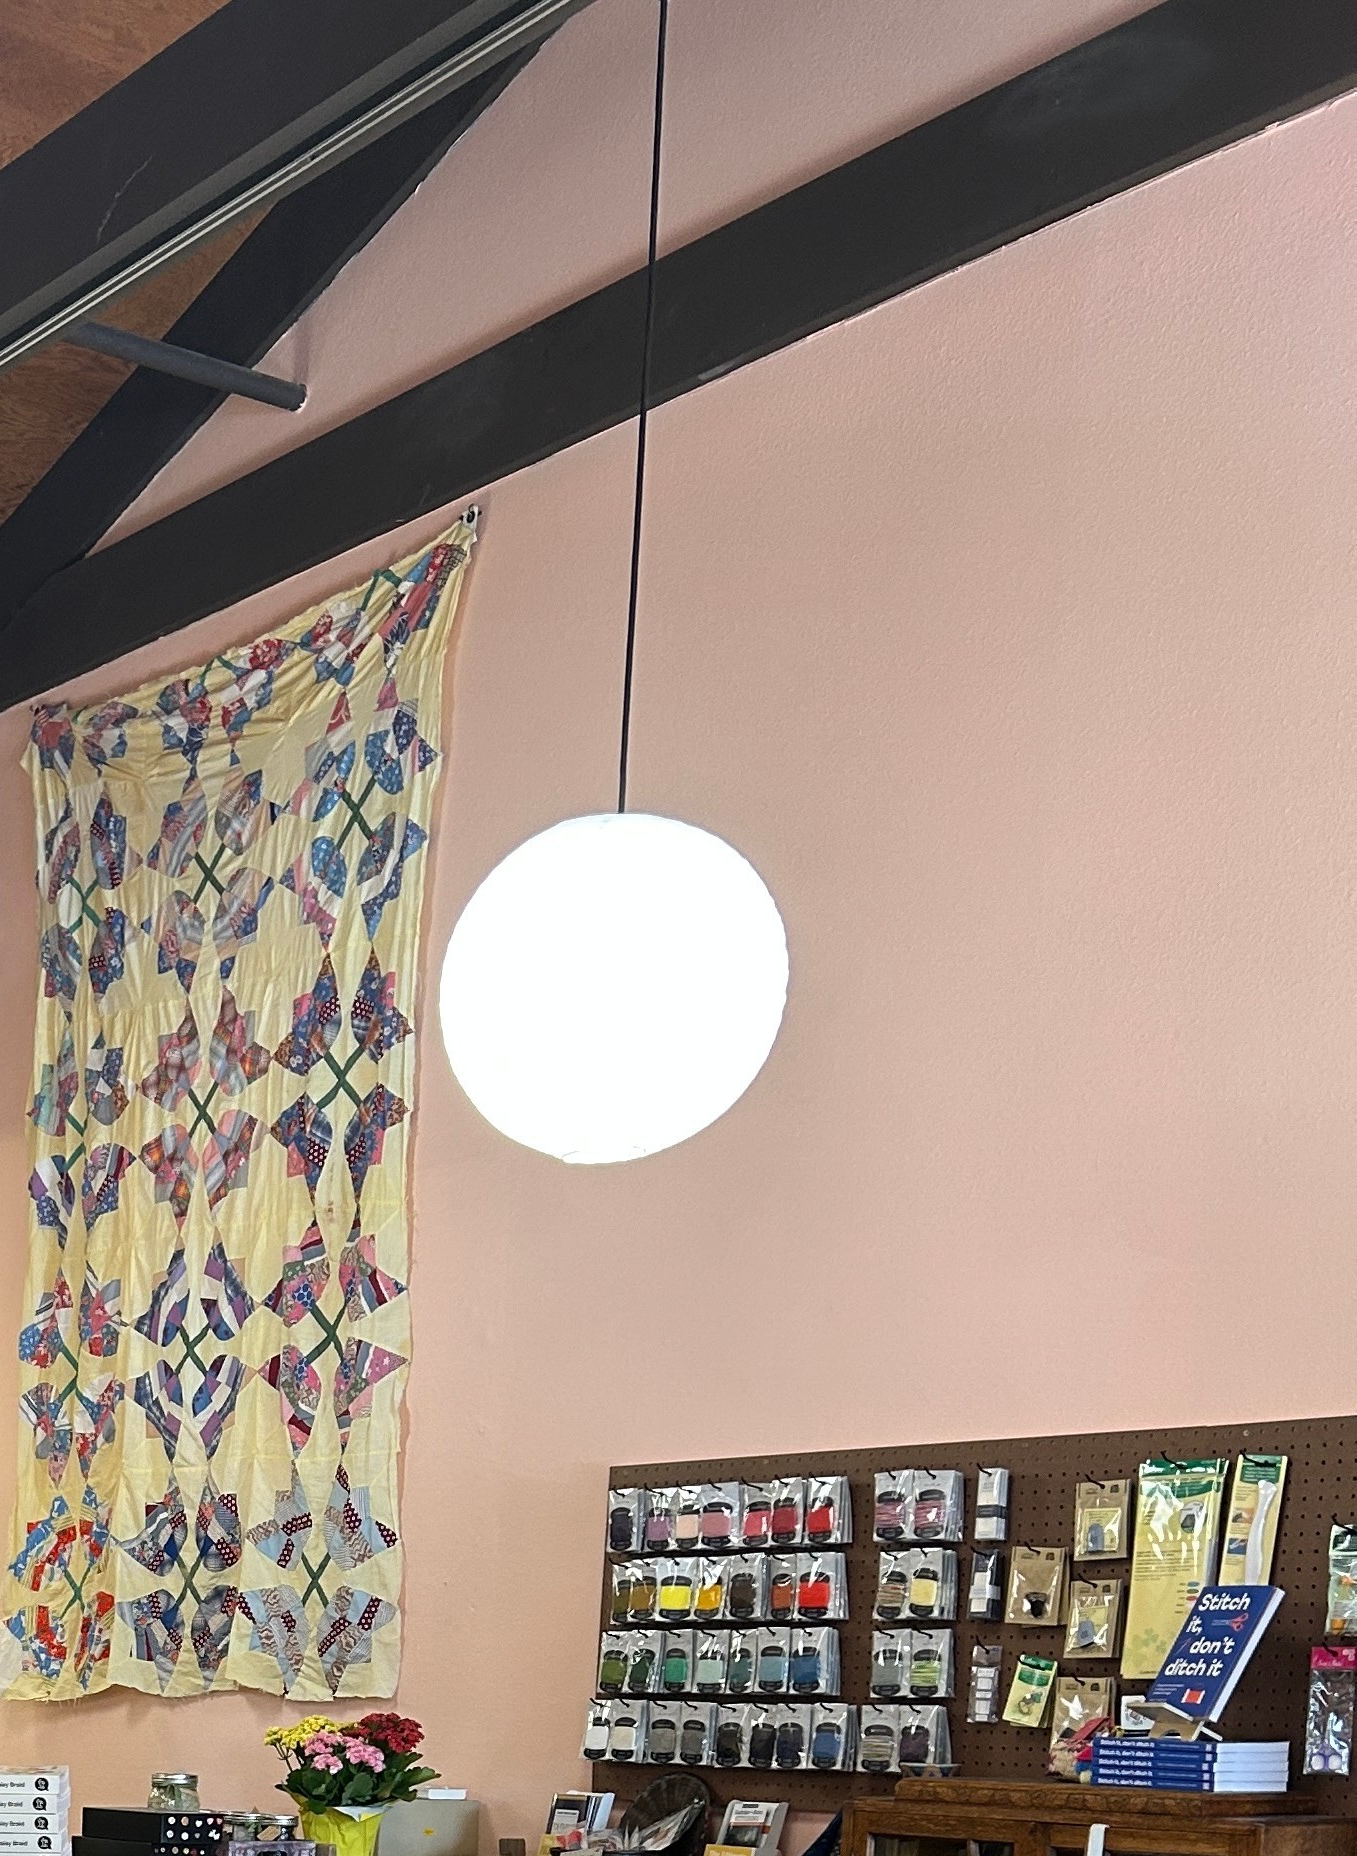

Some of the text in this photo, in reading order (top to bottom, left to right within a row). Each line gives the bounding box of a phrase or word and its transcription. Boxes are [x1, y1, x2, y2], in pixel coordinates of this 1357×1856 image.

[1198, 1592, 1251, 1611] Stitch
[1186, 1615, 1203, 1635] it,
[1189, 1636, 1235, 1654] don't
[1164, 1658, 1224, 1676] ditch it
